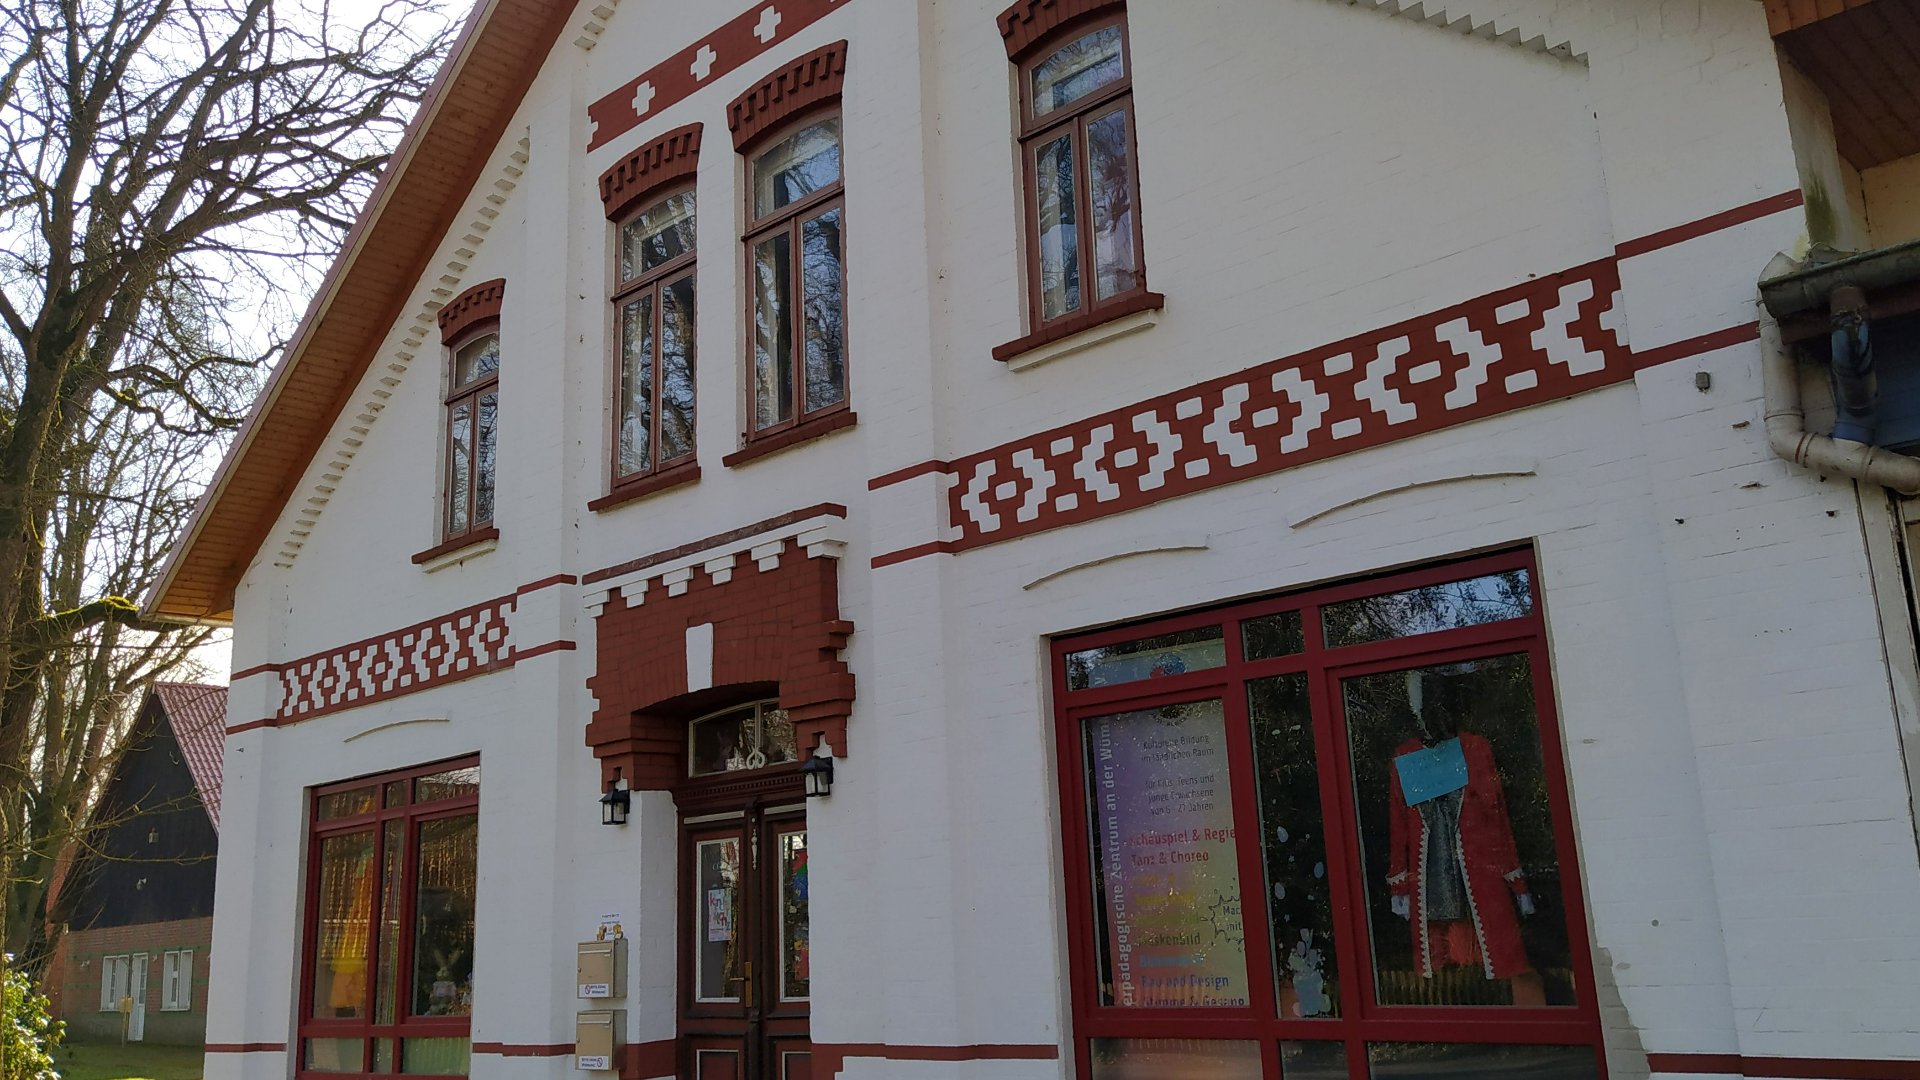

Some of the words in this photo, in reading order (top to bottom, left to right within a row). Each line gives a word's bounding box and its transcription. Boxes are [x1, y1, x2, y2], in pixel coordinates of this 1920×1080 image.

[1180, 735, 1210, 747] Bildung
[1192, 748, 1214, 757] Raum
[1102, 764, 1115, 788] der
[1200, 773, 1214, 784] und
[1106, 793, 1117, 811] an
[1188, 801, 1214, 813] Jahren
[1130, 829, 1188, 847] Schauspiel
[1192, 828, 1201, 841] &
[1204, 826, 1236, 844] Regie
[1108, 815, 1122, 880] Zentrum
[1131, 853, 1156, 867] Tanz
[1190, 973, 1229, 991] Design
